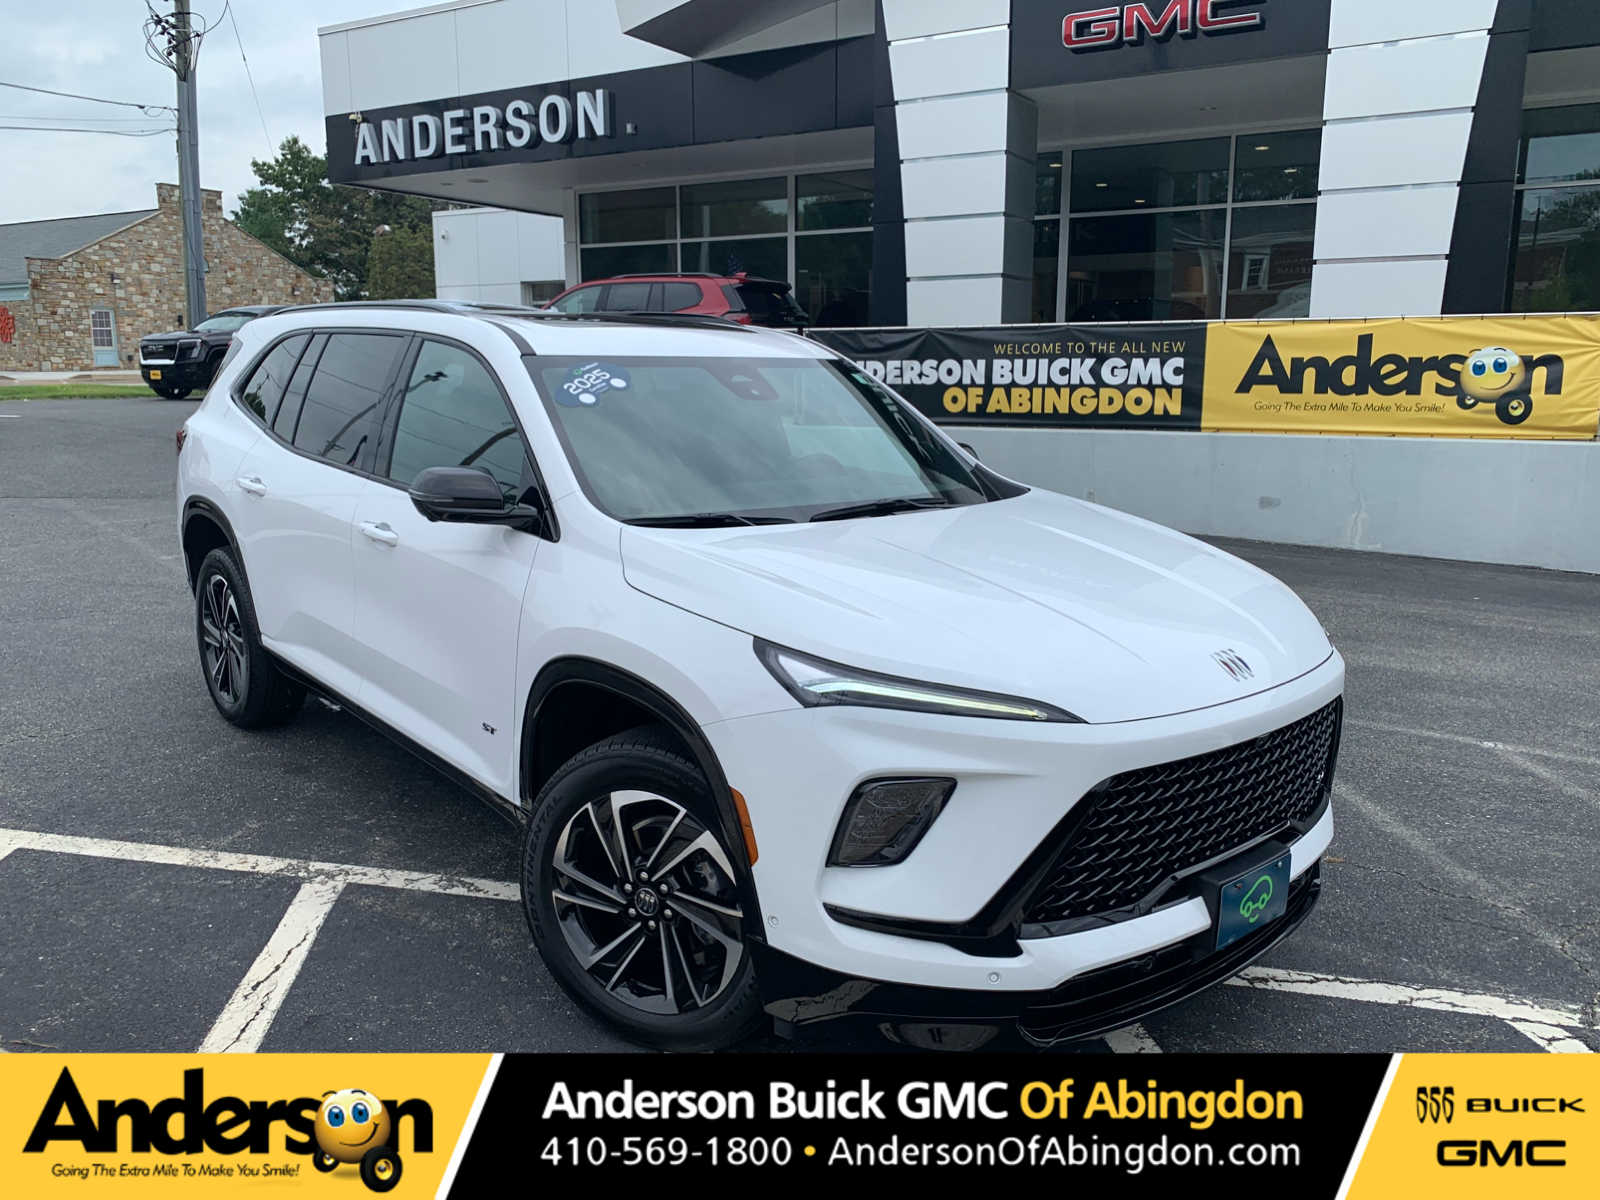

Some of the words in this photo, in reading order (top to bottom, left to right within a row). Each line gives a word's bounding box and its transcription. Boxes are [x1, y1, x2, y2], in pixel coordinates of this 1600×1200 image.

[1062, 0, 1260, 48] GMC
[354, 88, 608, 165] ANDERSON
[993, 342, 1062, 355] WELCOME
[1067, 342, 1085, 354] TO
[1089, 341, 1116, 354] THE
[1121, 341, 1147, 354] ALL
[1152, 340, 1186, 353] NEW
[856, 359, 986, 385] DERSON
[992, 357, 1097, 385] BUICK
[1100, 356, 1185, 385] GMC
[1235, 333, 1564, 396] Andersn
[563, 369, 610, 394] 2025
[942, 386, 984, 413] OF
[986, 386, 1183, 416] ABINGDON
[1254, 401, 1282, 412] Going
[1284, 401, 1300, 411] The
[1303, 402, 1327, 412] Extra
[1328, 402, 1349, 412] Mile
[1350, 402, 1362, 412] To
[1363, 402, 1392, 413] Make
[1394, 402, 1413, 413] You
[1414, 402, 1446, 413] Smile!
